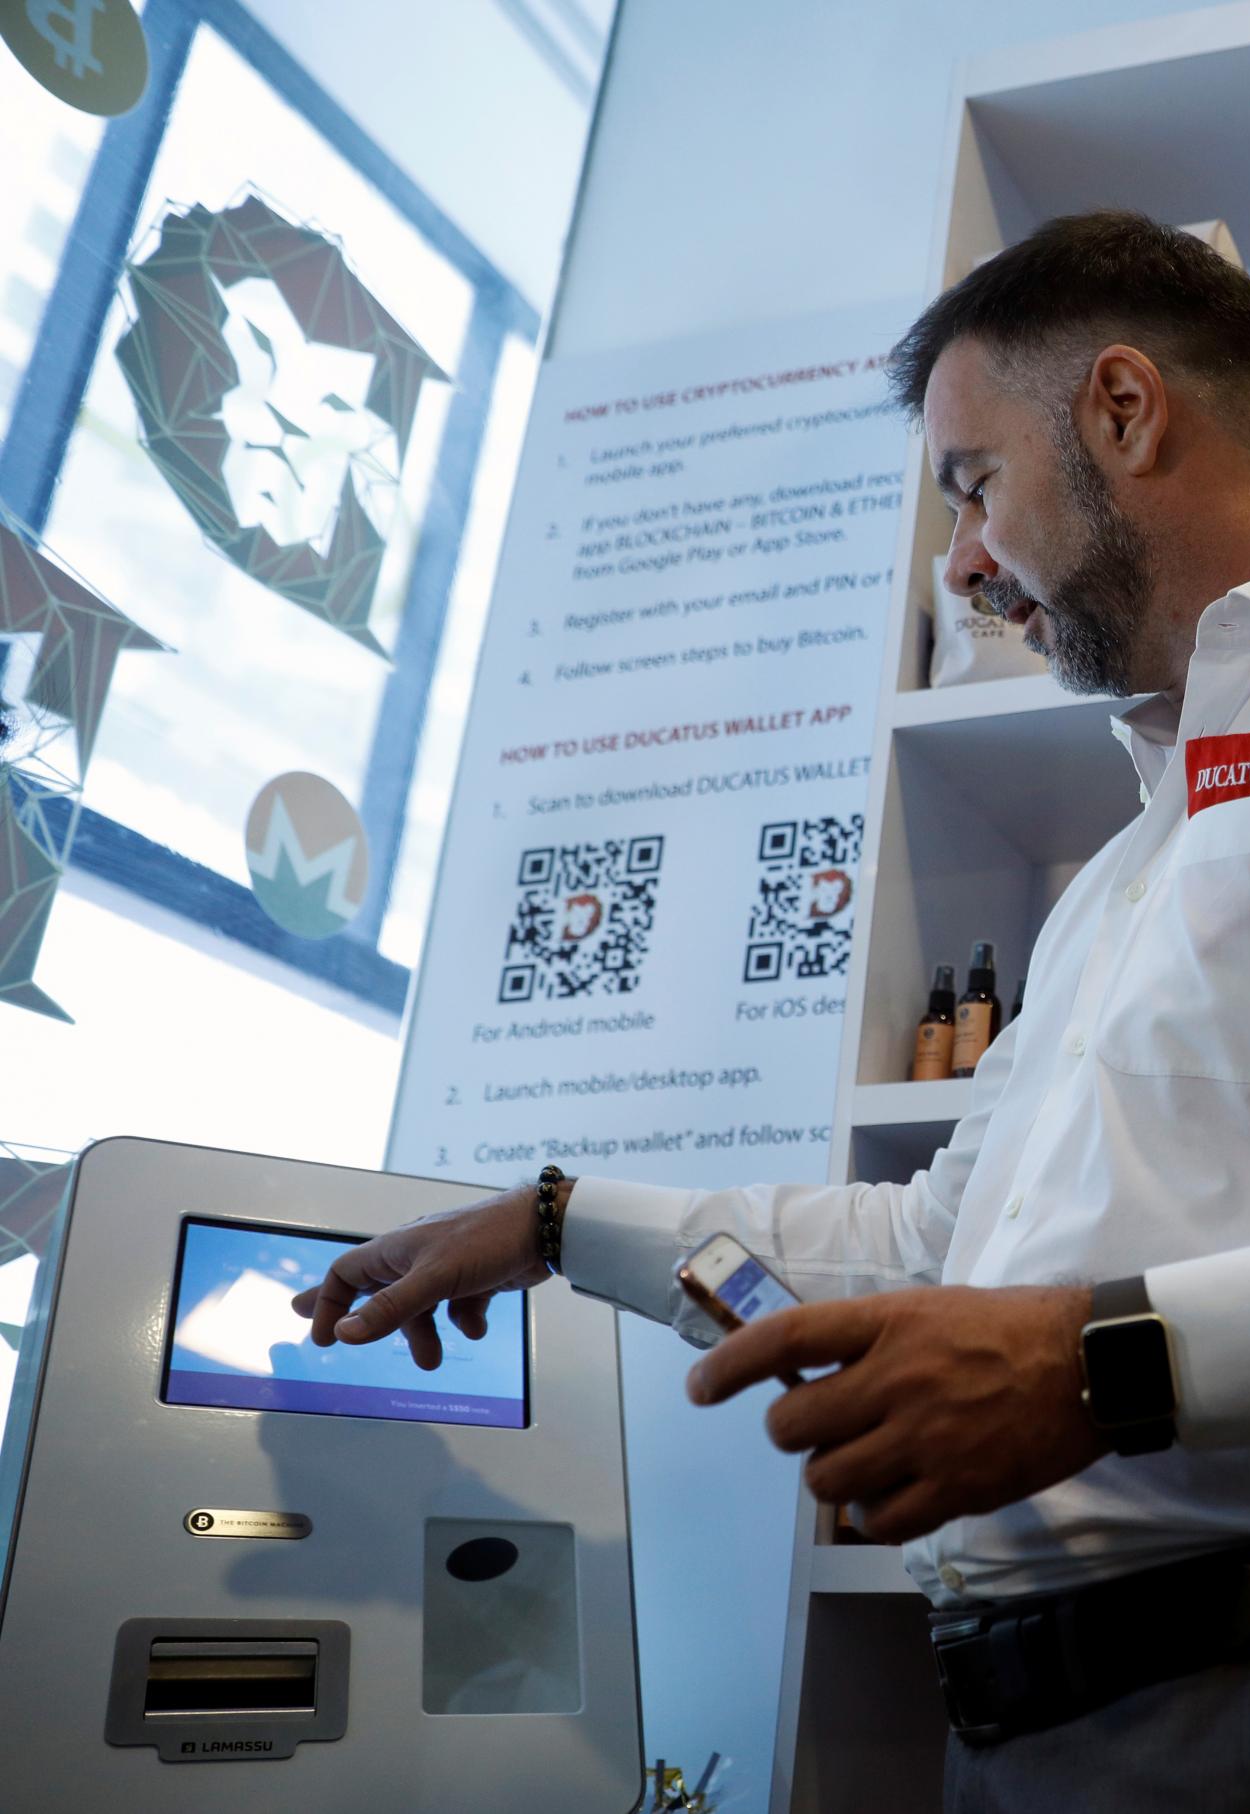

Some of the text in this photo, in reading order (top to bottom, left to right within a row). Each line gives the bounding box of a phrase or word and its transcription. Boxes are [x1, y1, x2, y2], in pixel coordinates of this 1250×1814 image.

[564, 403, 609, 424] HOW
[614, 398, 640, 414] TO
[642, 389, 677, 410] USE
[680, 359, 858, 403] CRYPTOCURRENCY
[590, 440, 652, 465] Launch
[656, 434, 696, 455] your
[699, 417, 784, 447] preferred
[584, 466, 643, 486] mobile
[582, 514, 597, 531] If
[597, 514, 630, 532] you
[681, 499, 725, 517] have
[768, 473, 863, 502] download
[576, 540, 613, 558] app
[615, 519, 732, 550] BLOCKCHAIN
[751, 503, 828, 529] BITCOIN
[829, 502, 843, 517] &
[573, 563, 614, 580] from
[617, 552, 682, 575] Google
[686, 544, 723, 564] Play
[727, 543, 748, 557] or
[752, 537, 790, 555] App
[564, 609, 634, 632] Register
[638, 599, 680, 619] with
[682, 596, 724, 617] your
[728, 582, 781, 607] email
[783, 578, 821, 600] and
[823, 572, 857, 592] PIN
[859, 570, 881, 588] or
[555, 660, 613, 682] Follow
[617, 653, 675, 673] screen
[680, 645, 728, 663] steps
[733, 640, 753, 656] to
[756, 635, 794, 655] buy
[500, 704, 853, 765] HOW TO USE DUCATUS WALLET APP
[528, 794, 571, 815] Scan
[574, 792, 595, 809] to
[598, 778, 693, 807] download
[697, 765, 790, 795] DUCATUS
[794, 755, 872, 783] WALLET
[472, 1009, 656, 1043] For Android mobile
[735, 1001, 769, 1021] For
[772, 996, 808, 1019] iOS
[484, 1077, 553, 1103] Launch
[558, 1066, 714, 1096] mobile/desktop
[718, 1066, 763, 1088] app.
[473, 1142, 537, 1164] Create
[694, 1126, 736, 1151] and
[738, 1123, 804, 1148] follow
[202, 1740, 273, 1753] LAMASSU
